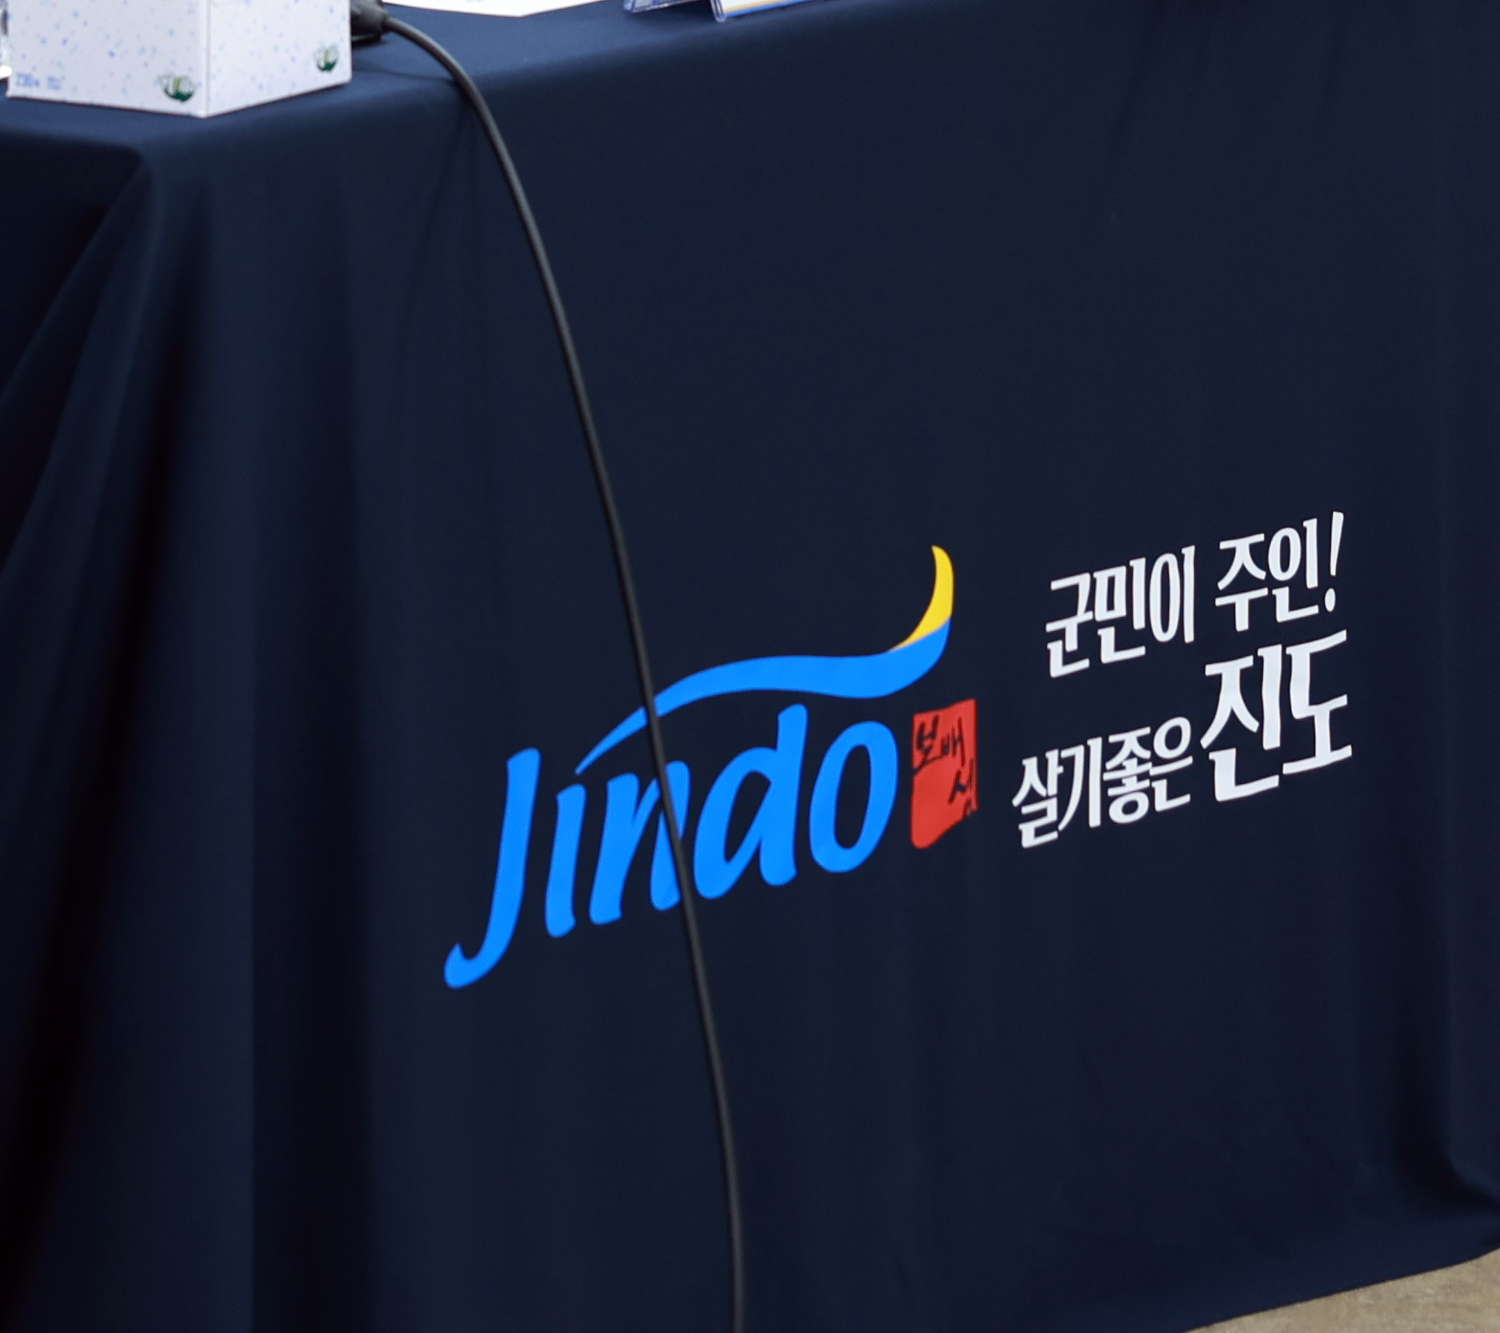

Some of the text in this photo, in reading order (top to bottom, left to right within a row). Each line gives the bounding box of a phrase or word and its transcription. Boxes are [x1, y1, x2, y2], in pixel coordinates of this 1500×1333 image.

[1045, 511, 1345, 678] 군민이 주인!
[443, 704, 899, 988] Jindo
[1011, 629, 1353, 849] 살기좋은 진도
